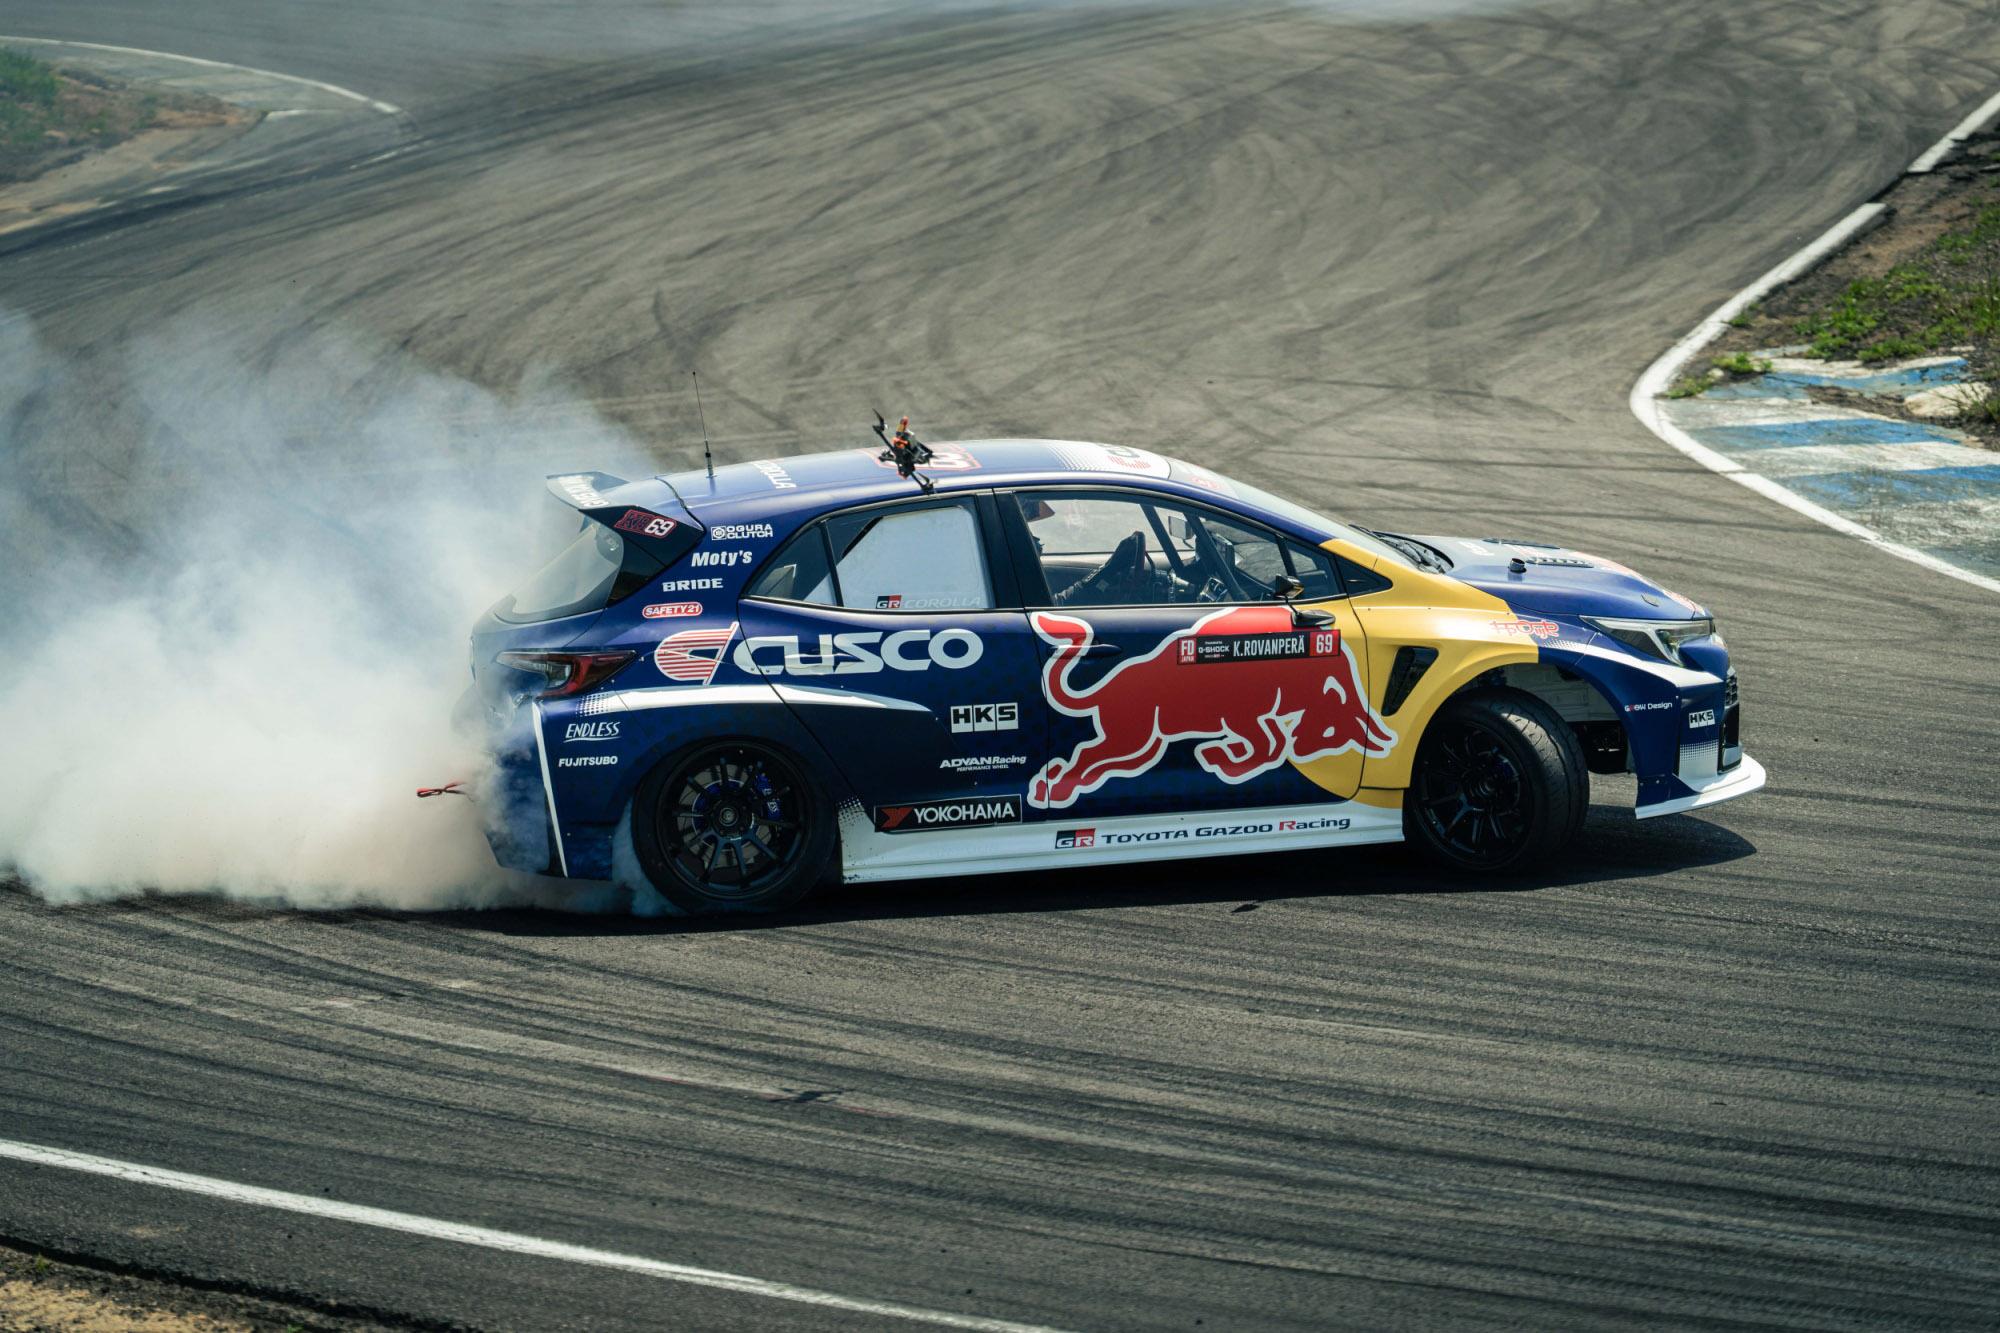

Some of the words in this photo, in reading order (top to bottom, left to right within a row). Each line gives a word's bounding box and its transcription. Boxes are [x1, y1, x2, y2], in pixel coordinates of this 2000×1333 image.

[727, 524, 773, 532] OGURA
[727, 531, 774, 539] CLUTCH
[691, 550, 753, 567] Moty's
[662, 578, 724, 592] BRIDE
[876, 600, 901, 609] GR
[904, 597, 981, 609] COROLLA
[733, 628, 984, 676] CUSCO
[1181, 639, 1195, 656] FD
[1233, 635, 1305, 657] K.ROVANPERÄ
[1316, 634, 1333, 654] 69
[952, 705, 1017, 724] HKS
[1647, 702, 1673, 710] Design
[1689, 711, 1714, 724] HKS
[565, 721, 621, 739] ENDLESS
[558, 756, 619, 767] FUJITSUBO
[914, 802, 1015, 823] YOKOHAMA
[1101, 830, 1188, 844] TOYOTA
[1195, 823, 1273, 837] GAZOO
[1279, 818, 1351, 831] Racing
